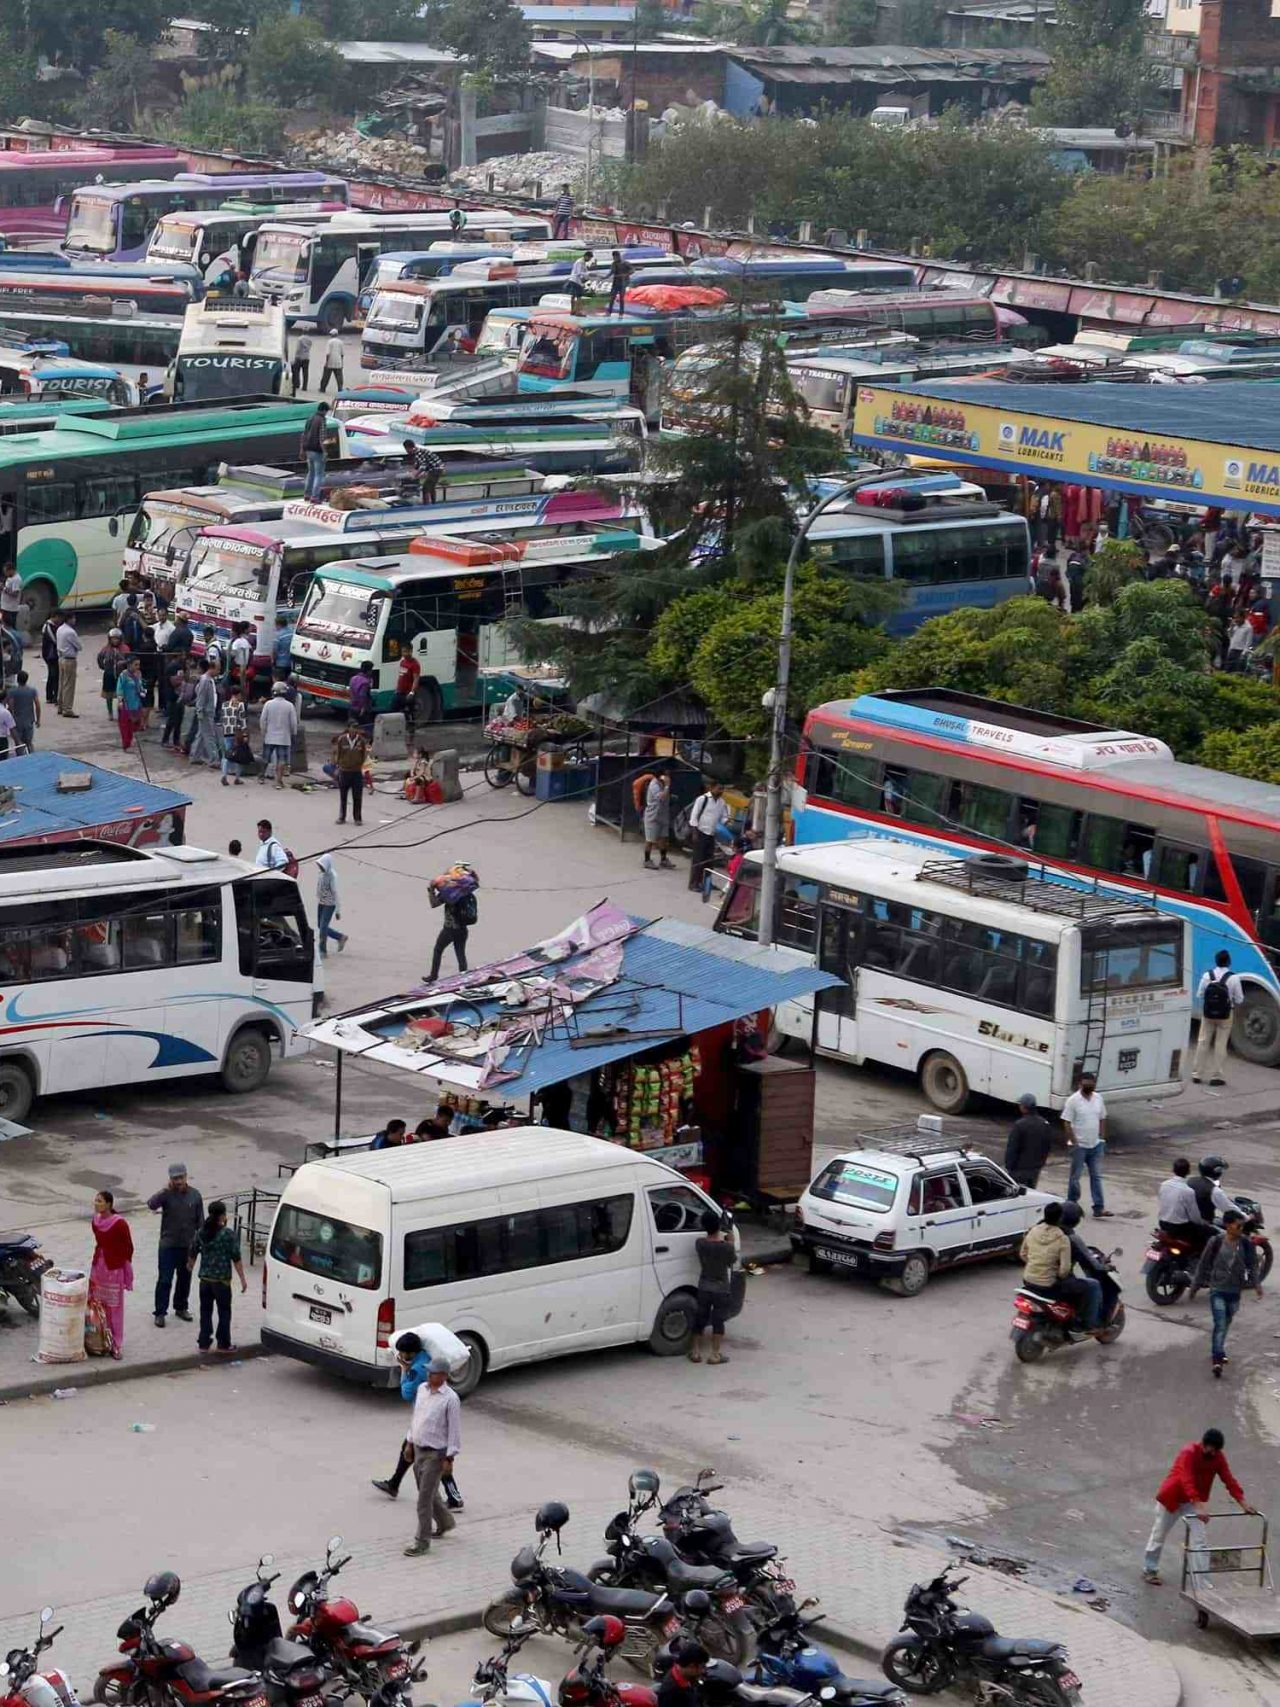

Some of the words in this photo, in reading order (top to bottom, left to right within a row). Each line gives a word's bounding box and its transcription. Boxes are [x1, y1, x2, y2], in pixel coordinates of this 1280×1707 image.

[181, 357, 277, 370] TOURIST
[41, 378, 113, 391] TOURIST
[1019, 426, 1065, 451] MAK
[1017, 446, 1064, 463] LUBRICANTS
[933, 716, 967, 733] BHUSAL
[971, 725, 1015, 744] TRAVELS
